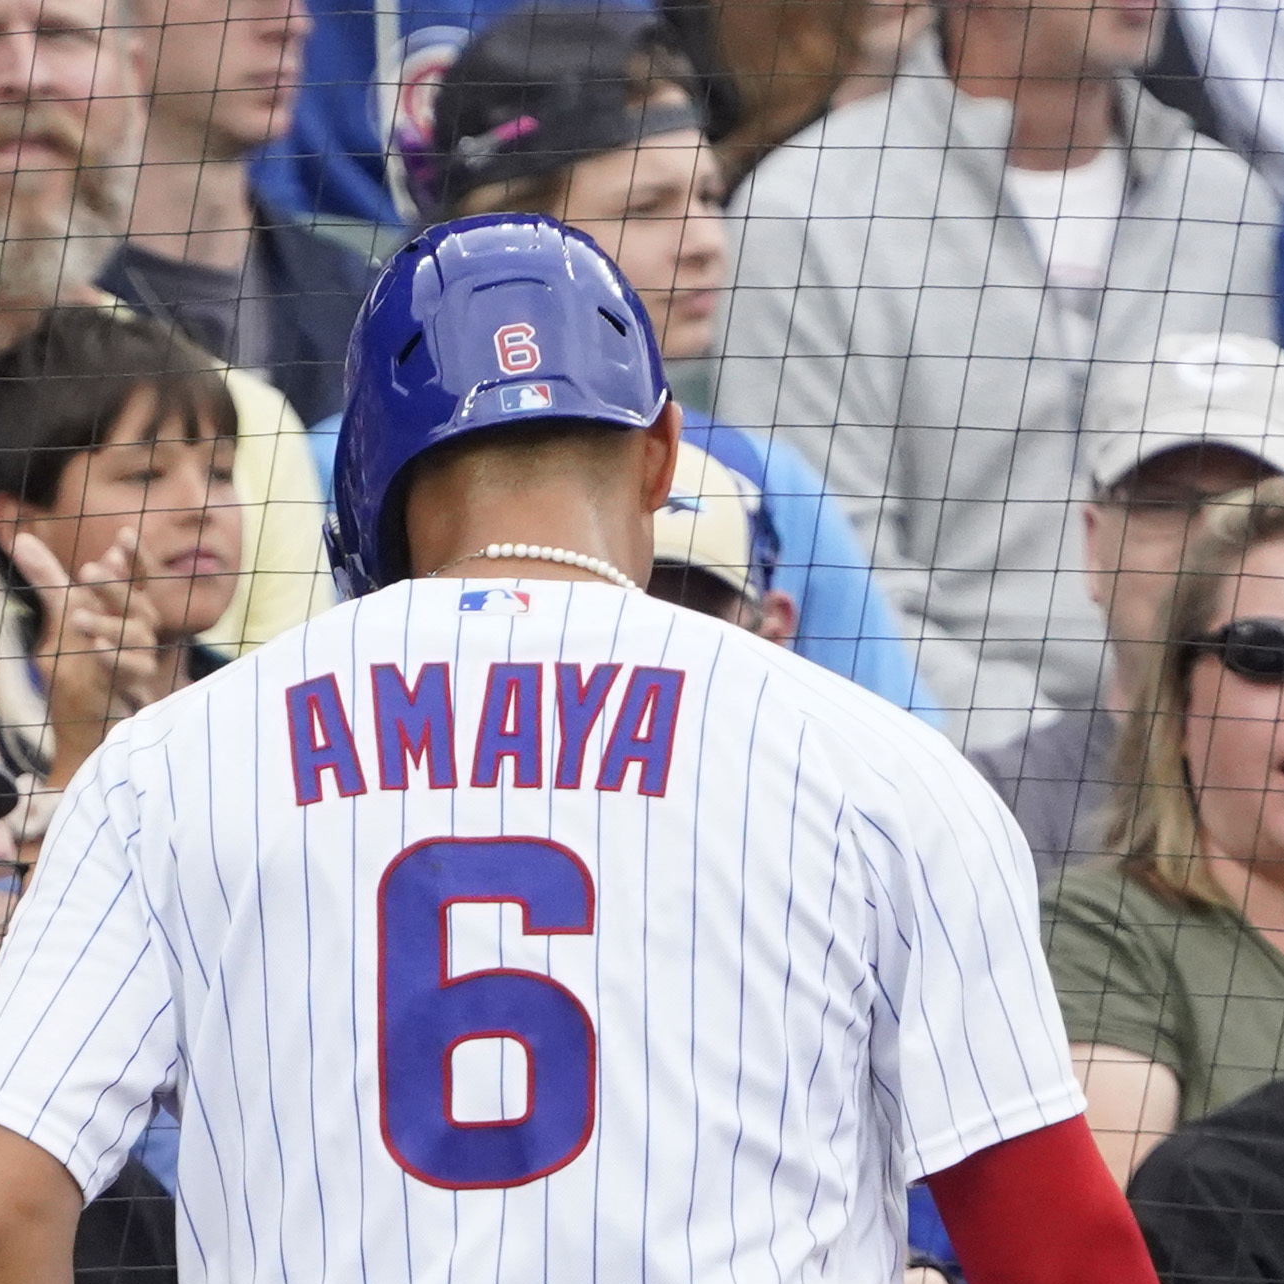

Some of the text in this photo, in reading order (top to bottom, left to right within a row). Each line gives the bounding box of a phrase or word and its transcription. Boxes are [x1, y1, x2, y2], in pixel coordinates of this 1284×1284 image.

[494, 322, 541, 375] 6
[285, 661, 686, 806] AMAYA
[376, 835, 596, 1191] 6
